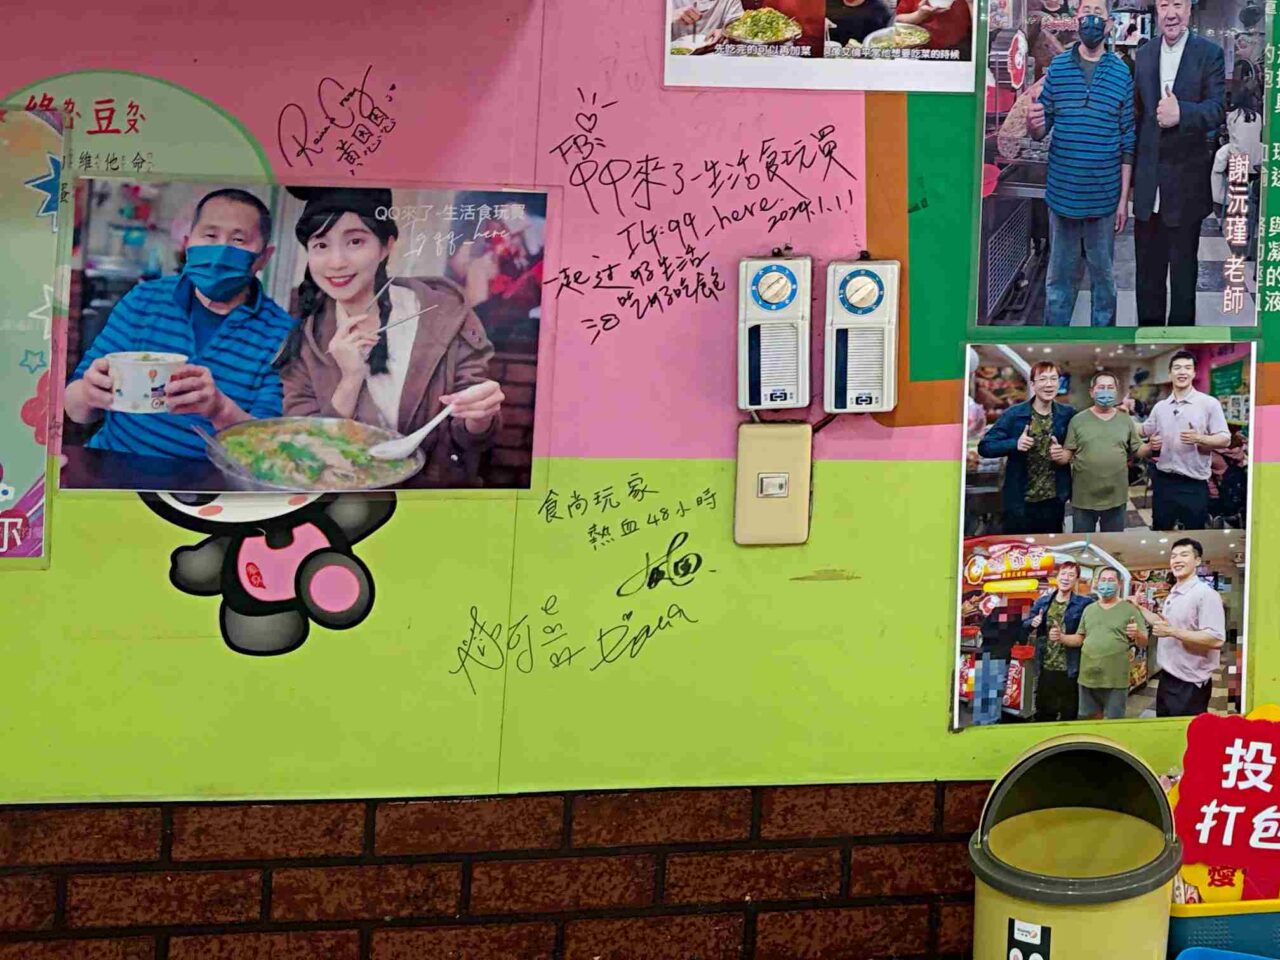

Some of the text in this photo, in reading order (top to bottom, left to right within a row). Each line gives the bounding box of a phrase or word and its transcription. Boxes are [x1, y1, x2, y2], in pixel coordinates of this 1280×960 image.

[1222, 256, 1247, 315] 老師
[538, 472, 659, 524] 食尚玩家
